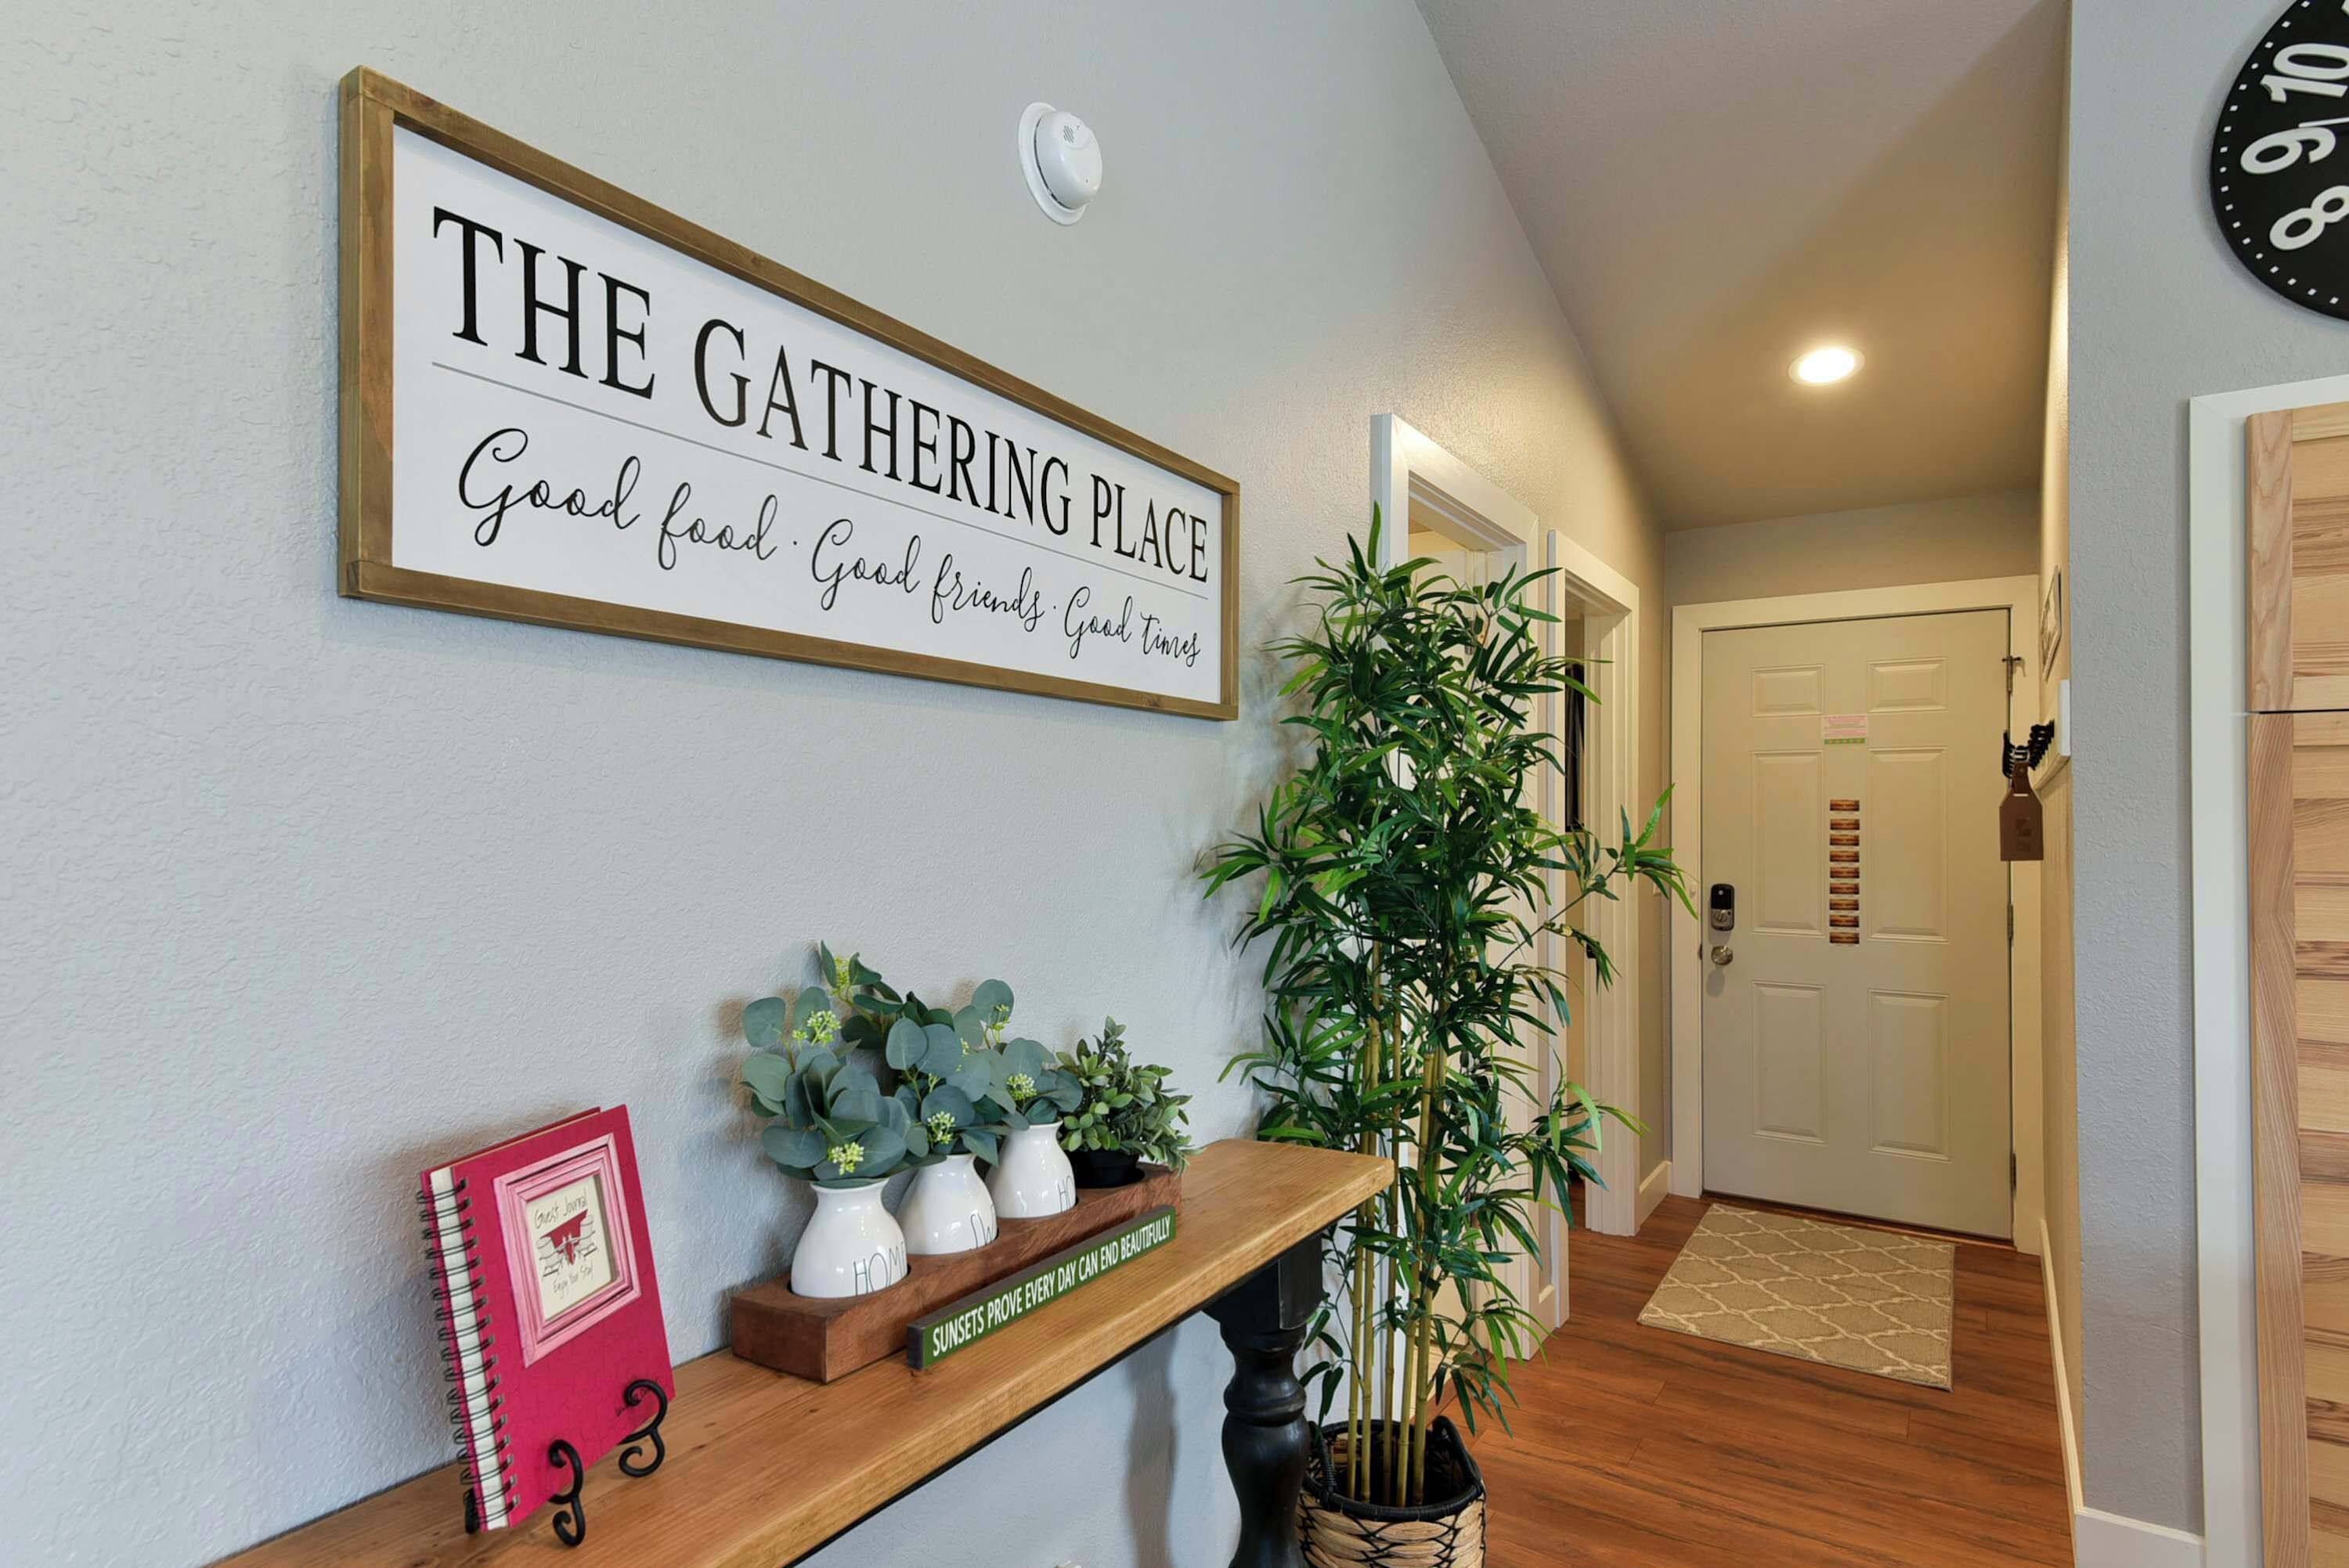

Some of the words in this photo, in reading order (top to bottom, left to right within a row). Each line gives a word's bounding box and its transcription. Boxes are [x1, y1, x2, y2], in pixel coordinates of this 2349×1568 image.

[2260, 42, 2349, 103] 10
[2240, 127, 2336, 175] 9
[2269, 185, 2349, 251] 8
[433, 206, 655, 400] THE
[694, 319, 1072, 537] GATHERING
[1089, 473, 1209, 584] PLACE
[458, 427, 640, 547] Good
[658, 481, 778, 571] food
[811, 518, 921, 611] Good
[931, 553, 1045, 633] friends
[1064, 586, 1132, 660] Good
[1140, 611, 1202, 668] times
[533, 1202, 560, 1230] Guest
[563, 1187, 587, 1217] Journal
[933, 1305, 984, 1357] SUNSETS
[987, 1287, 1023, 1328] PROVE
[1025, 1271, 1055, 1310] EVERY
[1058, 1260, 1077, 1292] DAY
[1078, 1250, 1099, 1281] CAN
[1100, 1241, 1119, 1271] END
[1120, 1215, 1171, 1261] BEAUTIFULLY
